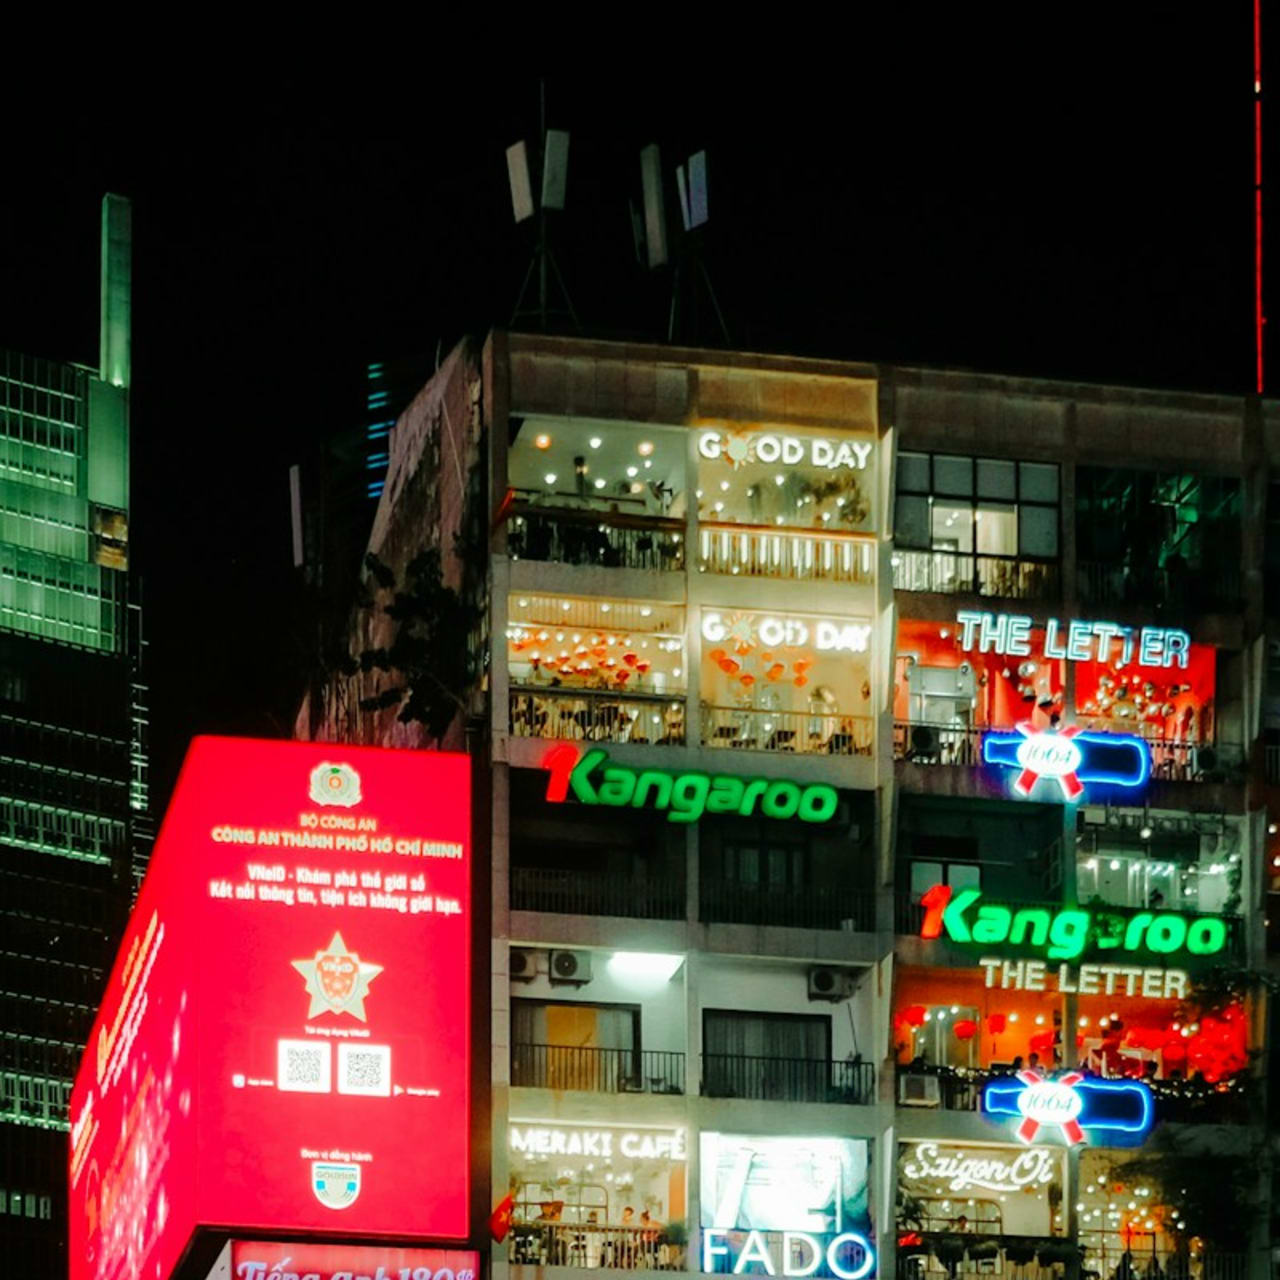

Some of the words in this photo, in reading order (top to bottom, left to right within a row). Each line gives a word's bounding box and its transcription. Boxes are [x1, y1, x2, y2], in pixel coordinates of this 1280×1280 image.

[810, 438, 872, 470] DAY
[816, 621, 873, 652] DAY
[957, 611, 1032, 656] THE
[1044, 619, 1191, 668] LETTER
[300, 813, 319, 829] BỘ
[320, 814, 356, 830] CÔNG
[358, 817, 377, 831] AN
[211, 825, 255, 844] CÔNG
[257, 830, 279, 845] AN
[281, 829, 333, 850] THÀNH
[335, 832, 369, 853] PHỐ
[395, 838, 421, 856] CHÍ
[422, 842, 463, 859] MINH
[979, 957, 1046, 991] THE
[1059, 963, 1188, 999] LETTER
[509, 1127, 613, 1157] MERAKI
[620, 1126, 688, 1160] CAFÉ
[703, 1229, 875, 1280] FADO
